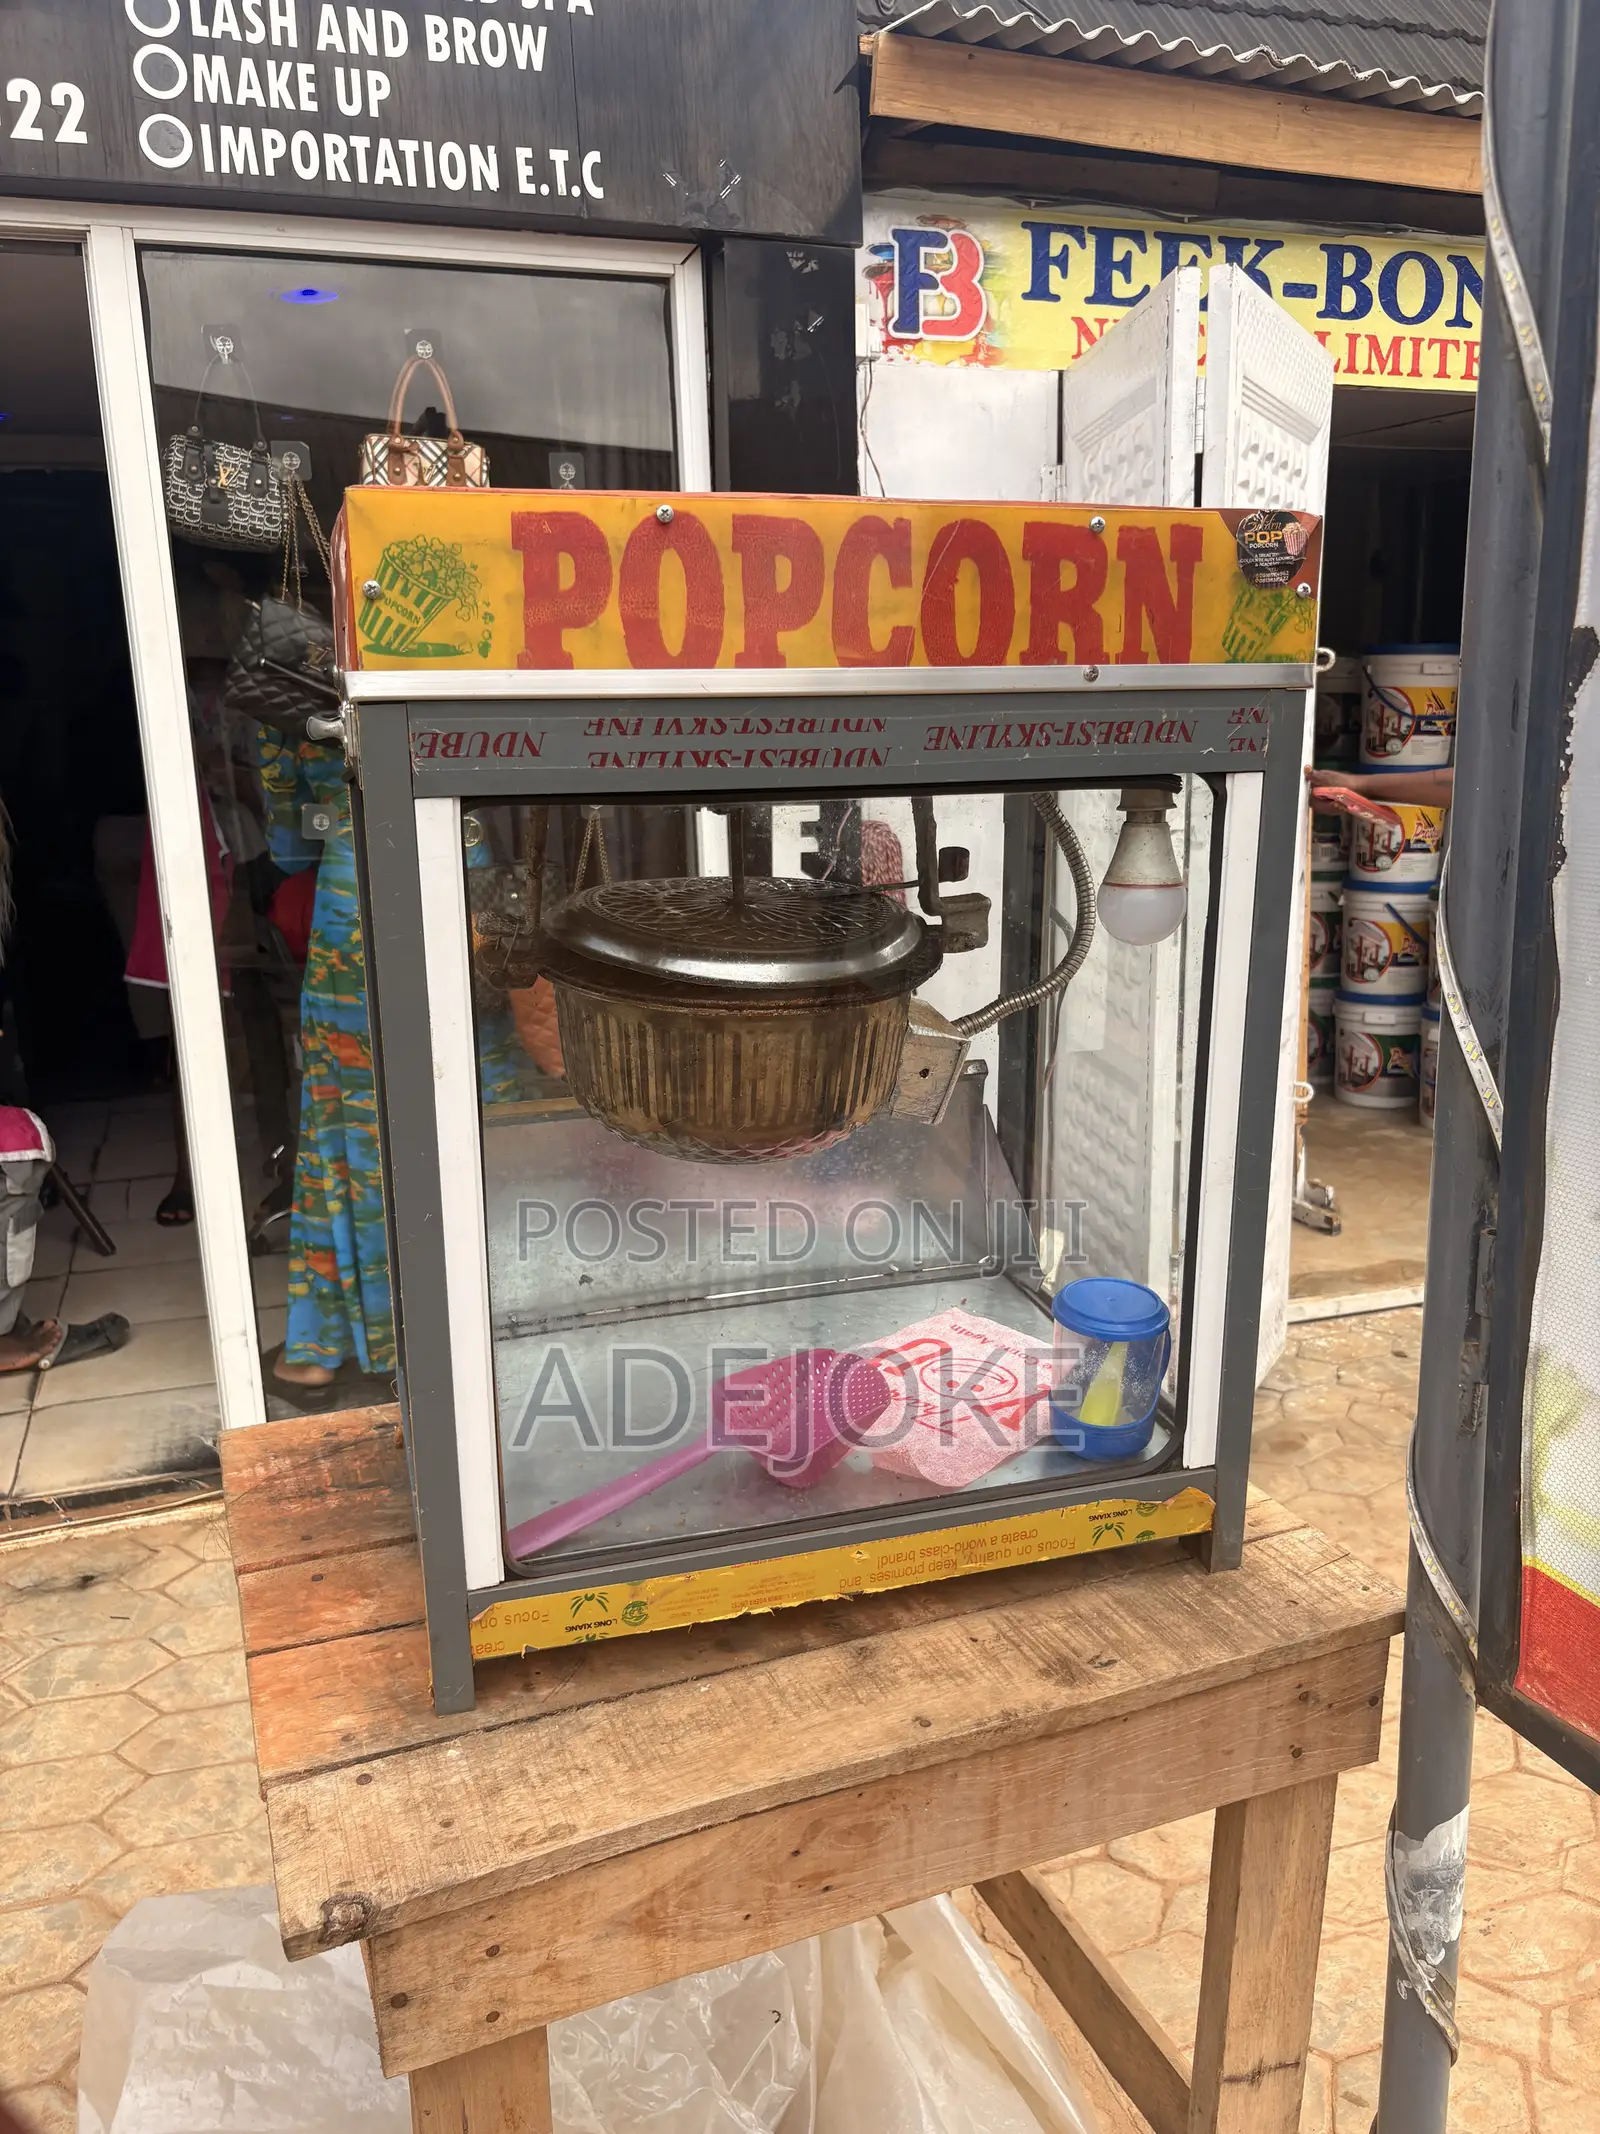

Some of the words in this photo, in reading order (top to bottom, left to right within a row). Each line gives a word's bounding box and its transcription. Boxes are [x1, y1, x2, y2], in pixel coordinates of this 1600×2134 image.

[190, 0, 297, 48] LASH
[317, 10, 409, 59] AND
[424, 14, 548, 72] BROW
[193, 53, 318, 113] MAKE
[335, 66, 391, 118] UP
[0, 77, 88, 145] 22
[200, 123, 500, 192] IMPORTATION
[1244, 531, 1283, 545] POP
[1249, 542, 1279, 550] POPCORN
[511, 509, 1204, 669] POPCORN
[923, 718, 1199, 752] NDUBEST-SKYLINE
[411, 731, 548, 759] NDUBE
[950, 1323, 992, 1346] Again
[1089, 1512, 1113, 1523] XIANG
[1112, 1508, 1133, 1518] LONG
[989, 1536, 998, 1546] a
[1000, 1527, 1038, 1546] create
[1036, 1536, 1076, 1554] Focus
[919, 1538, 987, 1558] world-class
[1016, 1544, 1032, 1557] on
[877, 1549, 916, 1569] brand!
[927, 1556, 958, 1574] keep
[838, 1576, 862, 1591] and
[479, 1616, 497, 1630] on
[504, 1609, 549, 1627] Focus
[593, 1618, 618, 1629] LONG
[565, 1622, 593, 1633] XIANG
